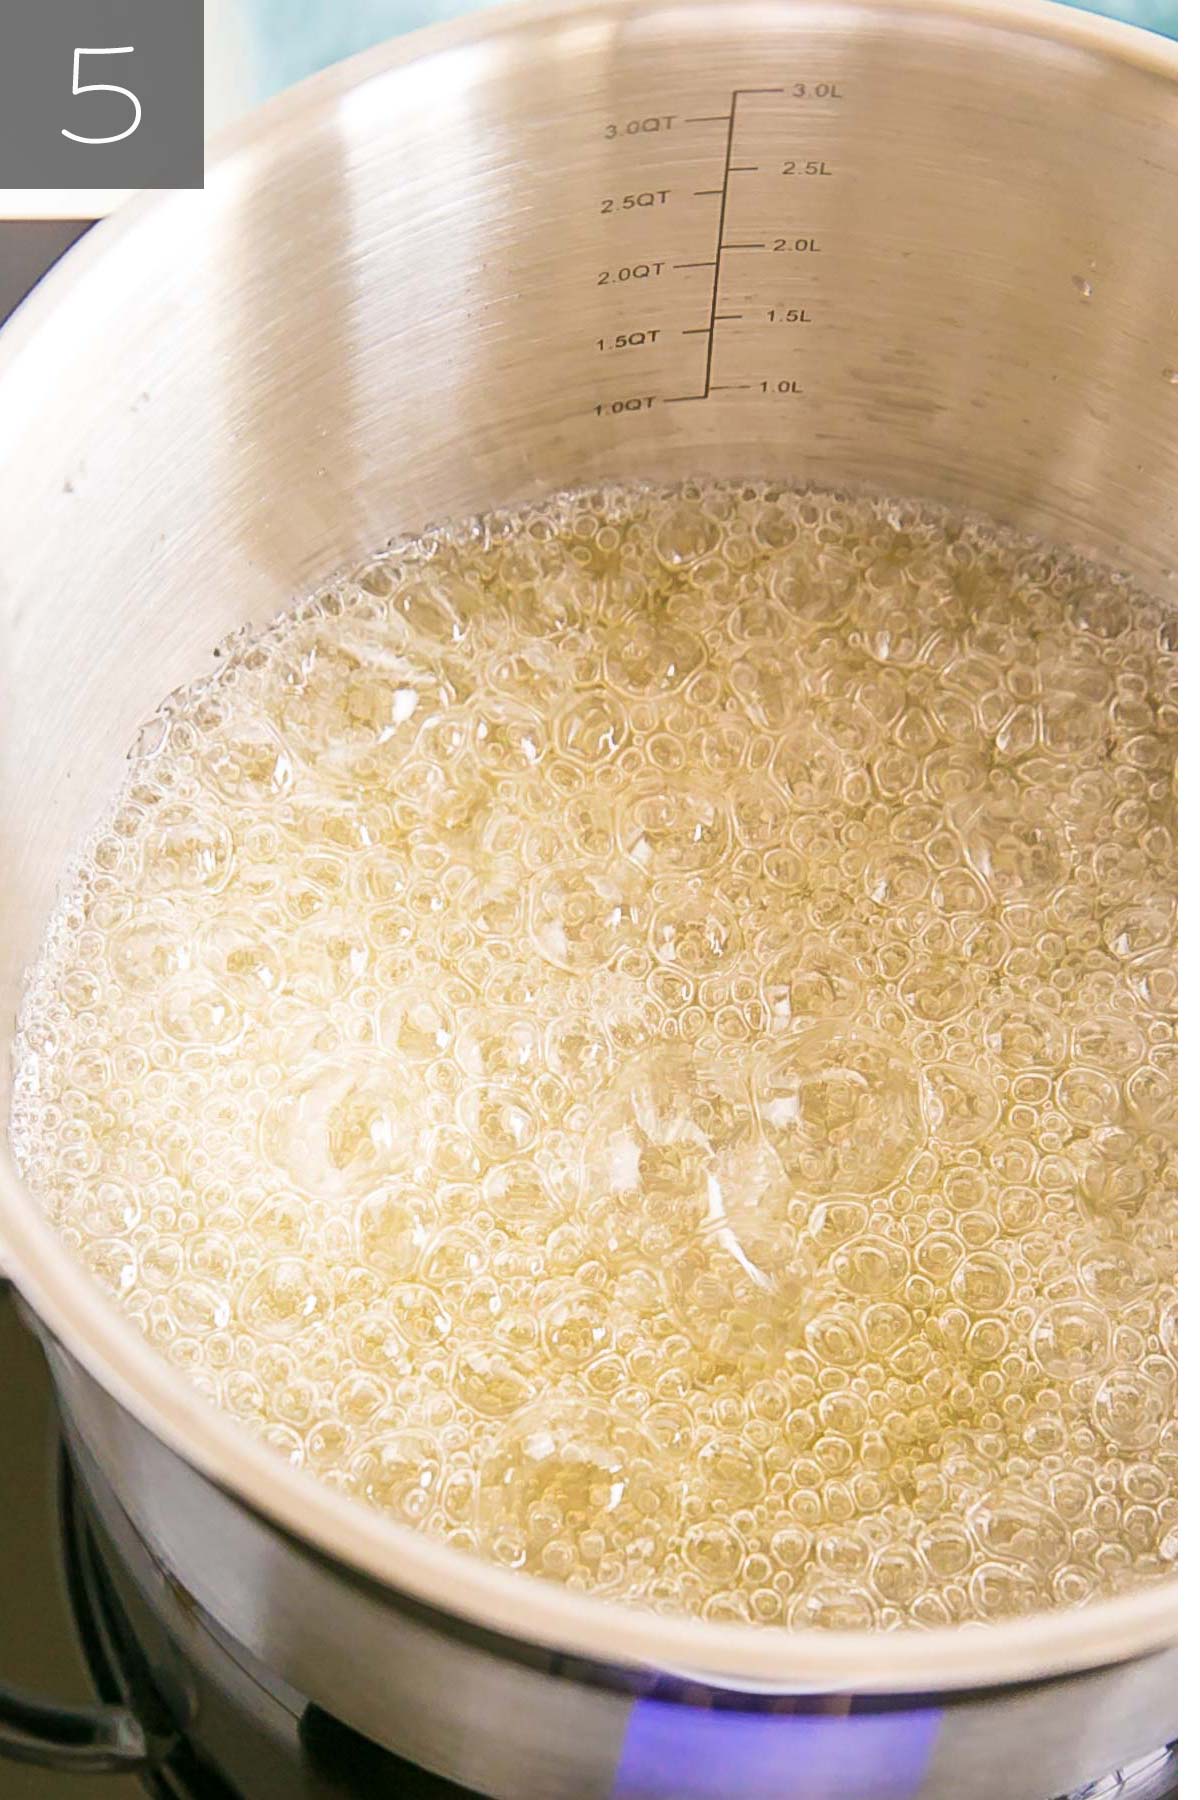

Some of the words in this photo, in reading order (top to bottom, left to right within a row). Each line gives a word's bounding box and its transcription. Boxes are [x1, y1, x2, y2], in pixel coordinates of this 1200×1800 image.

[792, 84, 843, 98] 3.0L
[605, 116, 679, 140] 3.0QT
[782, 161, 833, 176] 2.5L
[600, 190, 672, 214] 2.5QT
[773, 239, 821, 252] 2.0L
[597, 262, 666, 286] 2.0QT
[767, 310, 812, 322] 1.5L
[596, 330, 661, 351] 1.5QT
[761, 382, 803, 393] 1.0L
[593, 397, 657, 416] 1.0QT
